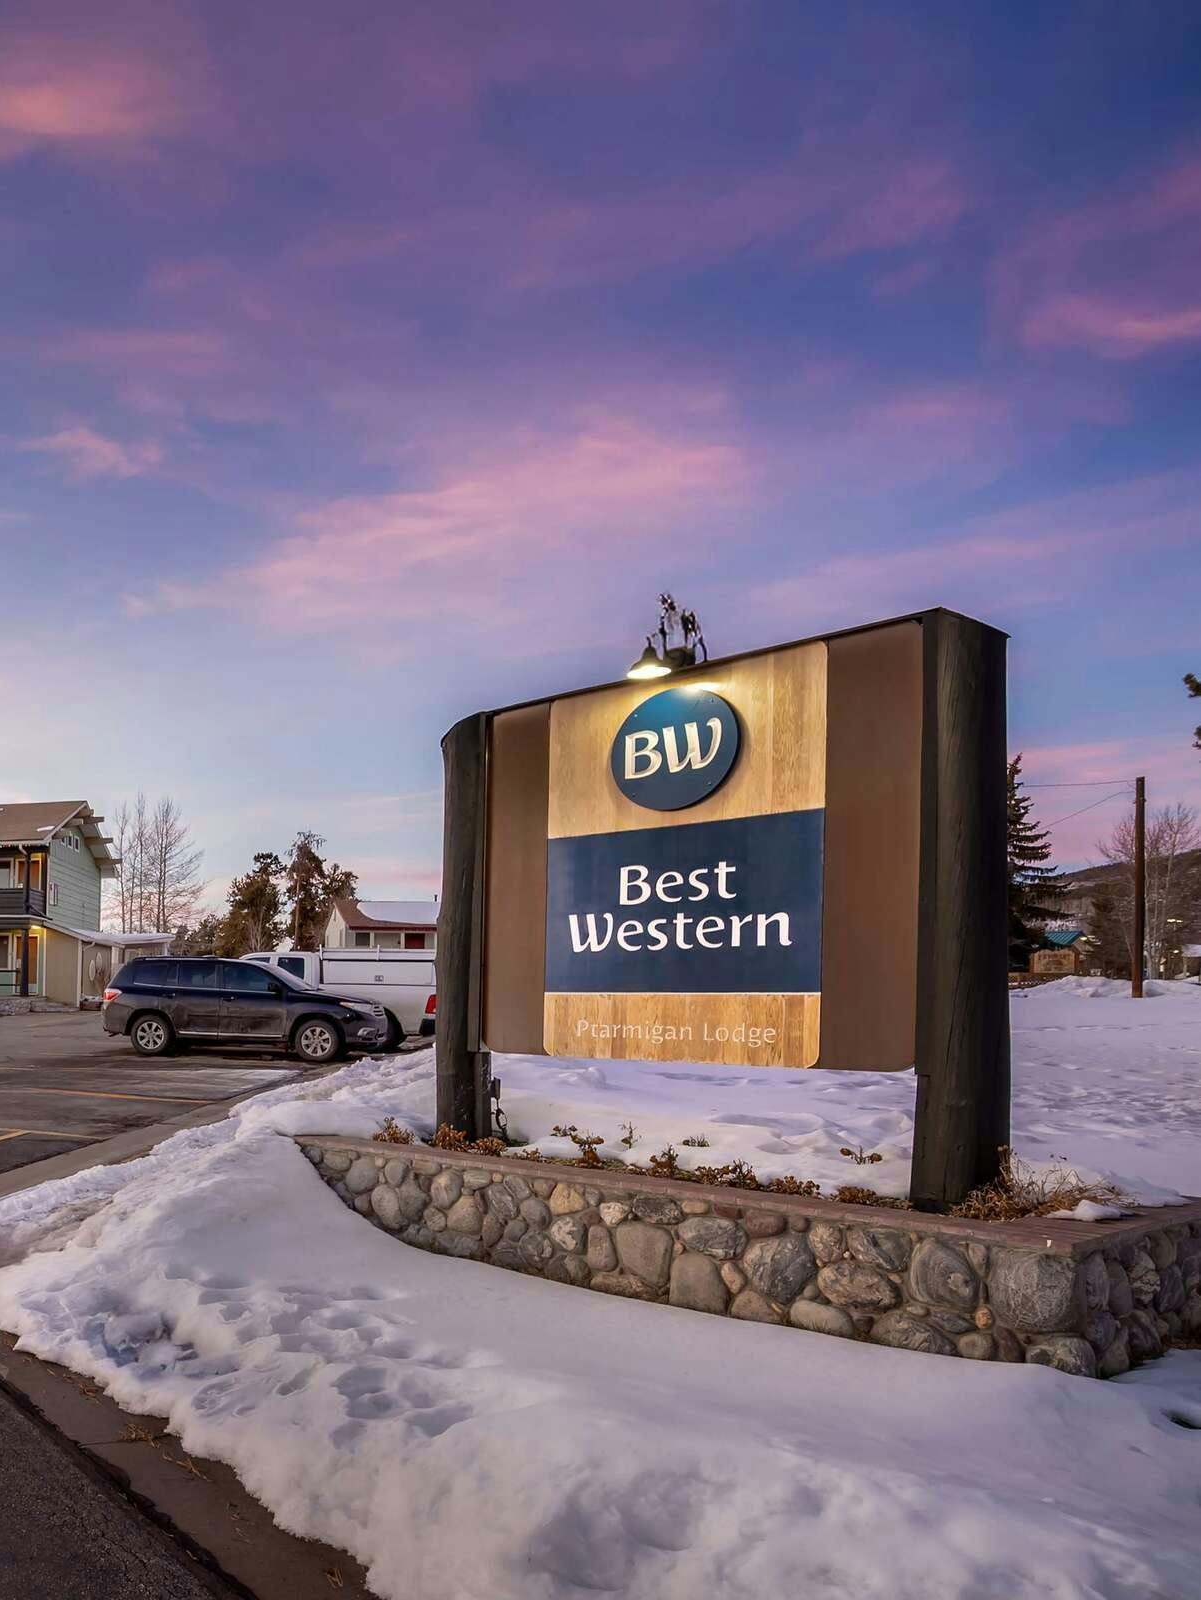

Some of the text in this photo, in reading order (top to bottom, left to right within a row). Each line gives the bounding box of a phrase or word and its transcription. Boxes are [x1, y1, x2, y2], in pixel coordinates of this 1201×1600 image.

[624, 717, 723, 780] BW
[619, 861, 737, 906] Best
[568, 911, 793, 953] Western
[575, 1019, 777, 1048] Ptarmigan Lodge
